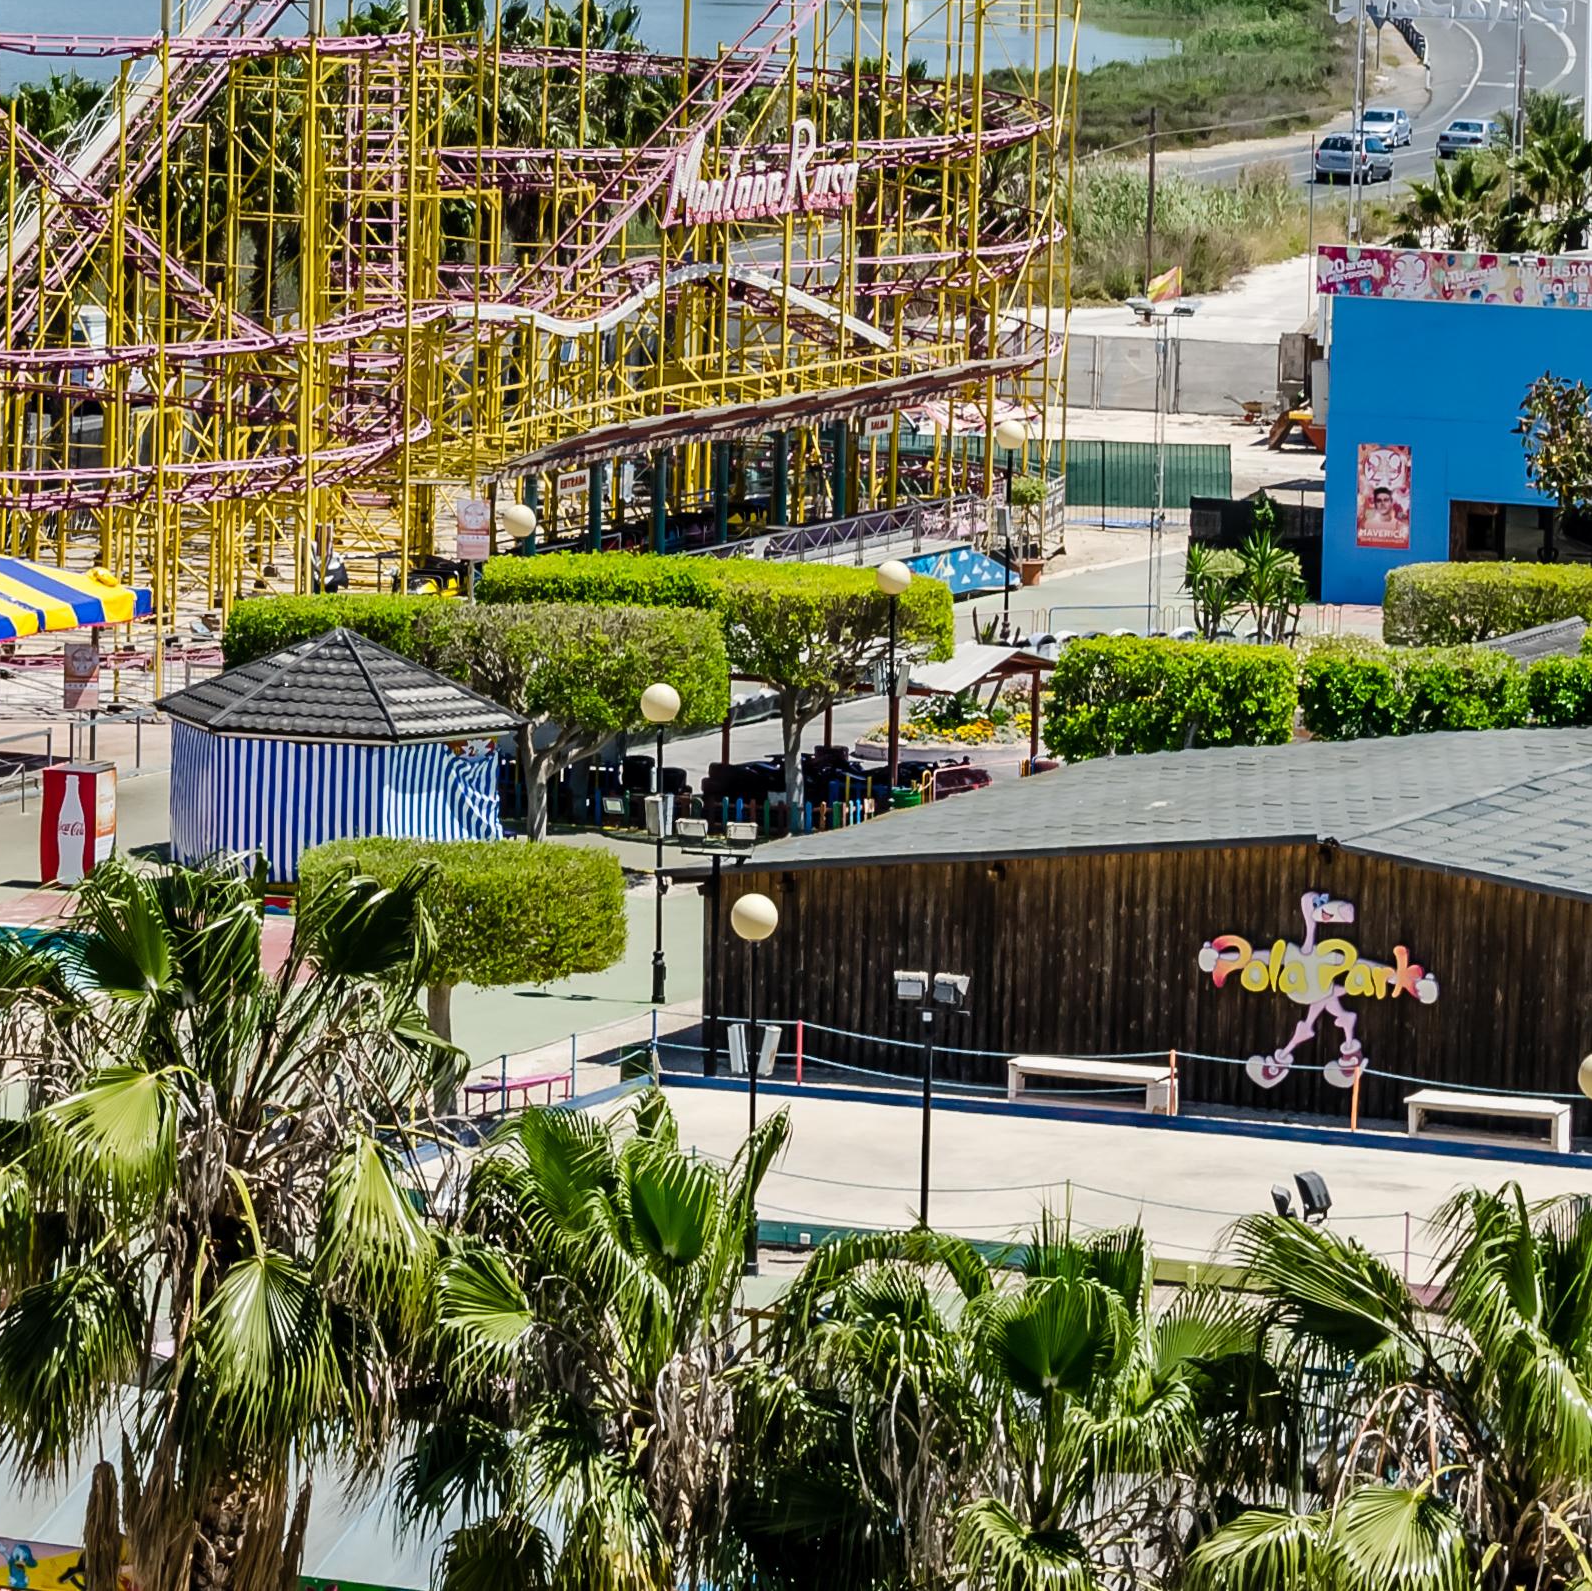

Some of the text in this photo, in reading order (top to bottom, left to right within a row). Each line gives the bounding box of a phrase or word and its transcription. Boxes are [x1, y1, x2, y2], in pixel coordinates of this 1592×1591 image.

[871, 419, 889, 431] SALIDA
[560, 475, 587, 489] ENTRADA
[1211, 933, 1426, 1003] Pola Park
